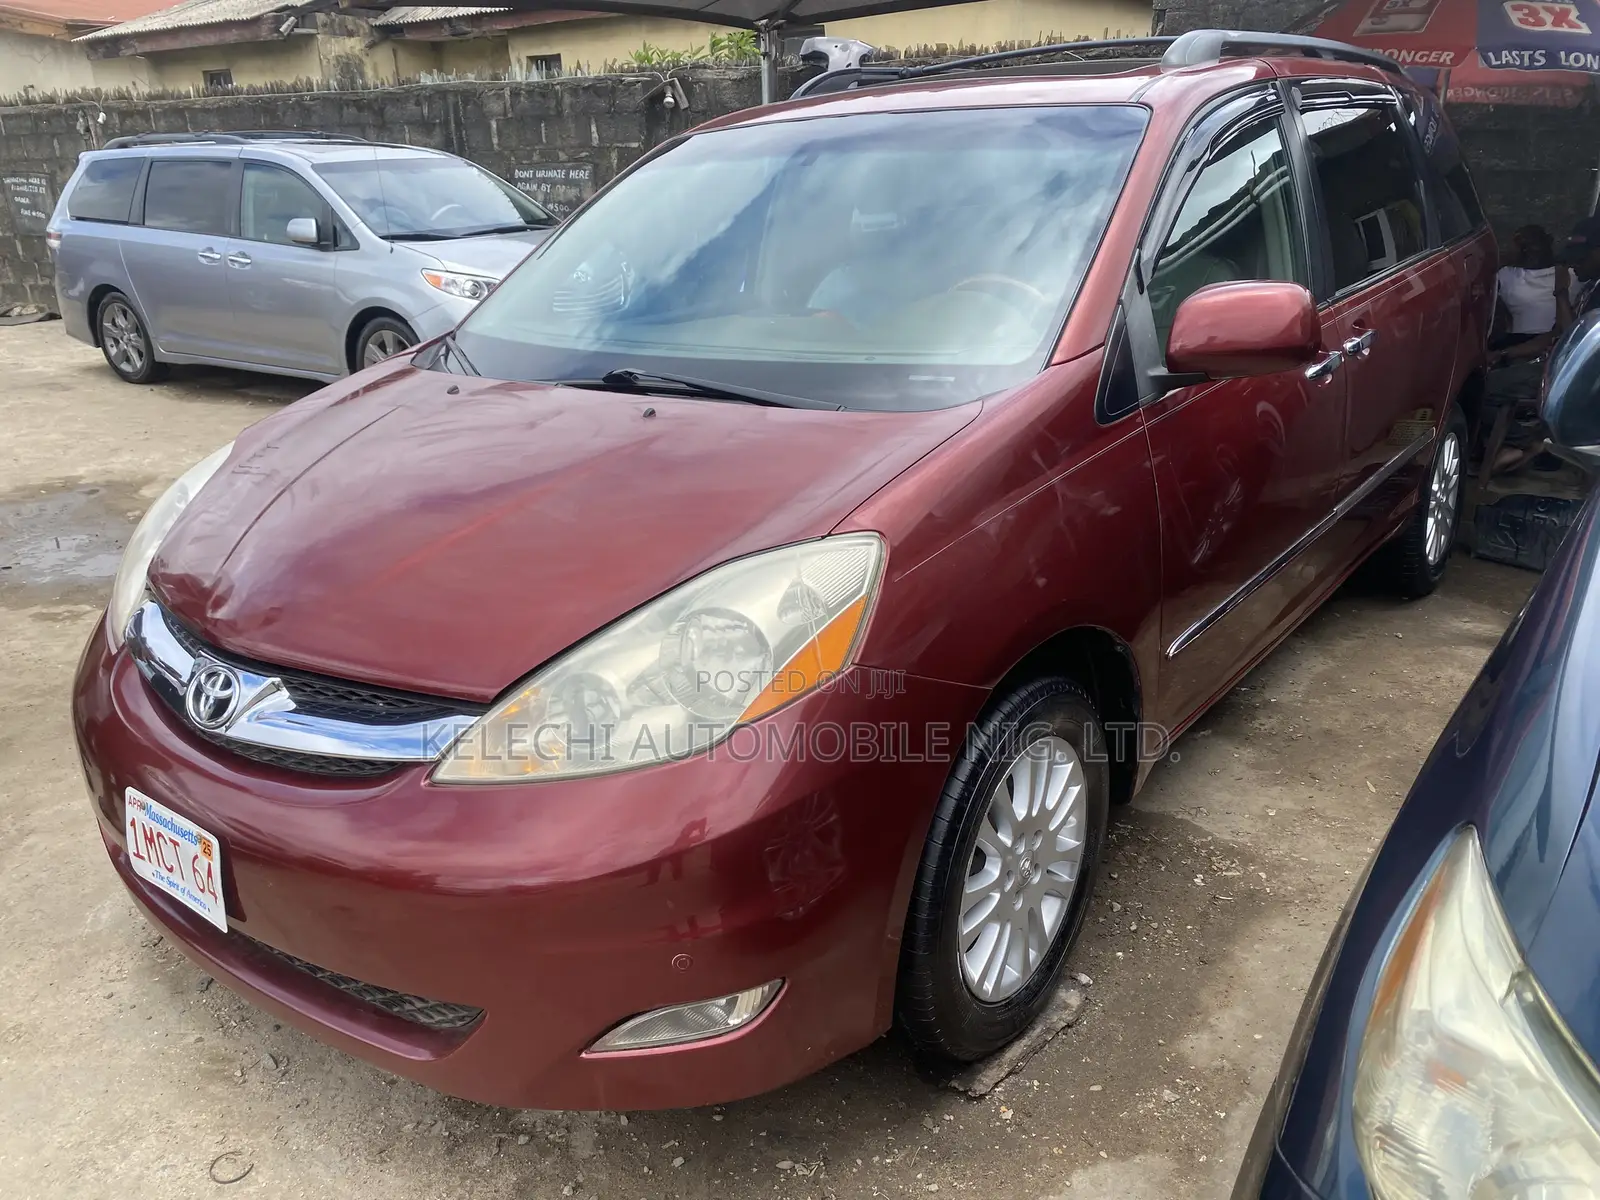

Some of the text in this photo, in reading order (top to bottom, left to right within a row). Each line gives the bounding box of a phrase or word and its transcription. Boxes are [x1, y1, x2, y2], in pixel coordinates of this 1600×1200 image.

[1508, 3, 1585, 30] 3X
[1488, 50, 1547, 67] LASTS
[536, 169, 566, 179] URINATE
[569, 169, 590, 180] HERE
[144, 801, 198, 847] Massachusetts
[130, 816, 218, 904] 1MCT 64
[202, 841, 212, 857] 25
[154, 869, 166, 883] The
[166, 875, 180, 892] Spirit
[186, 889, 207, 911] America
